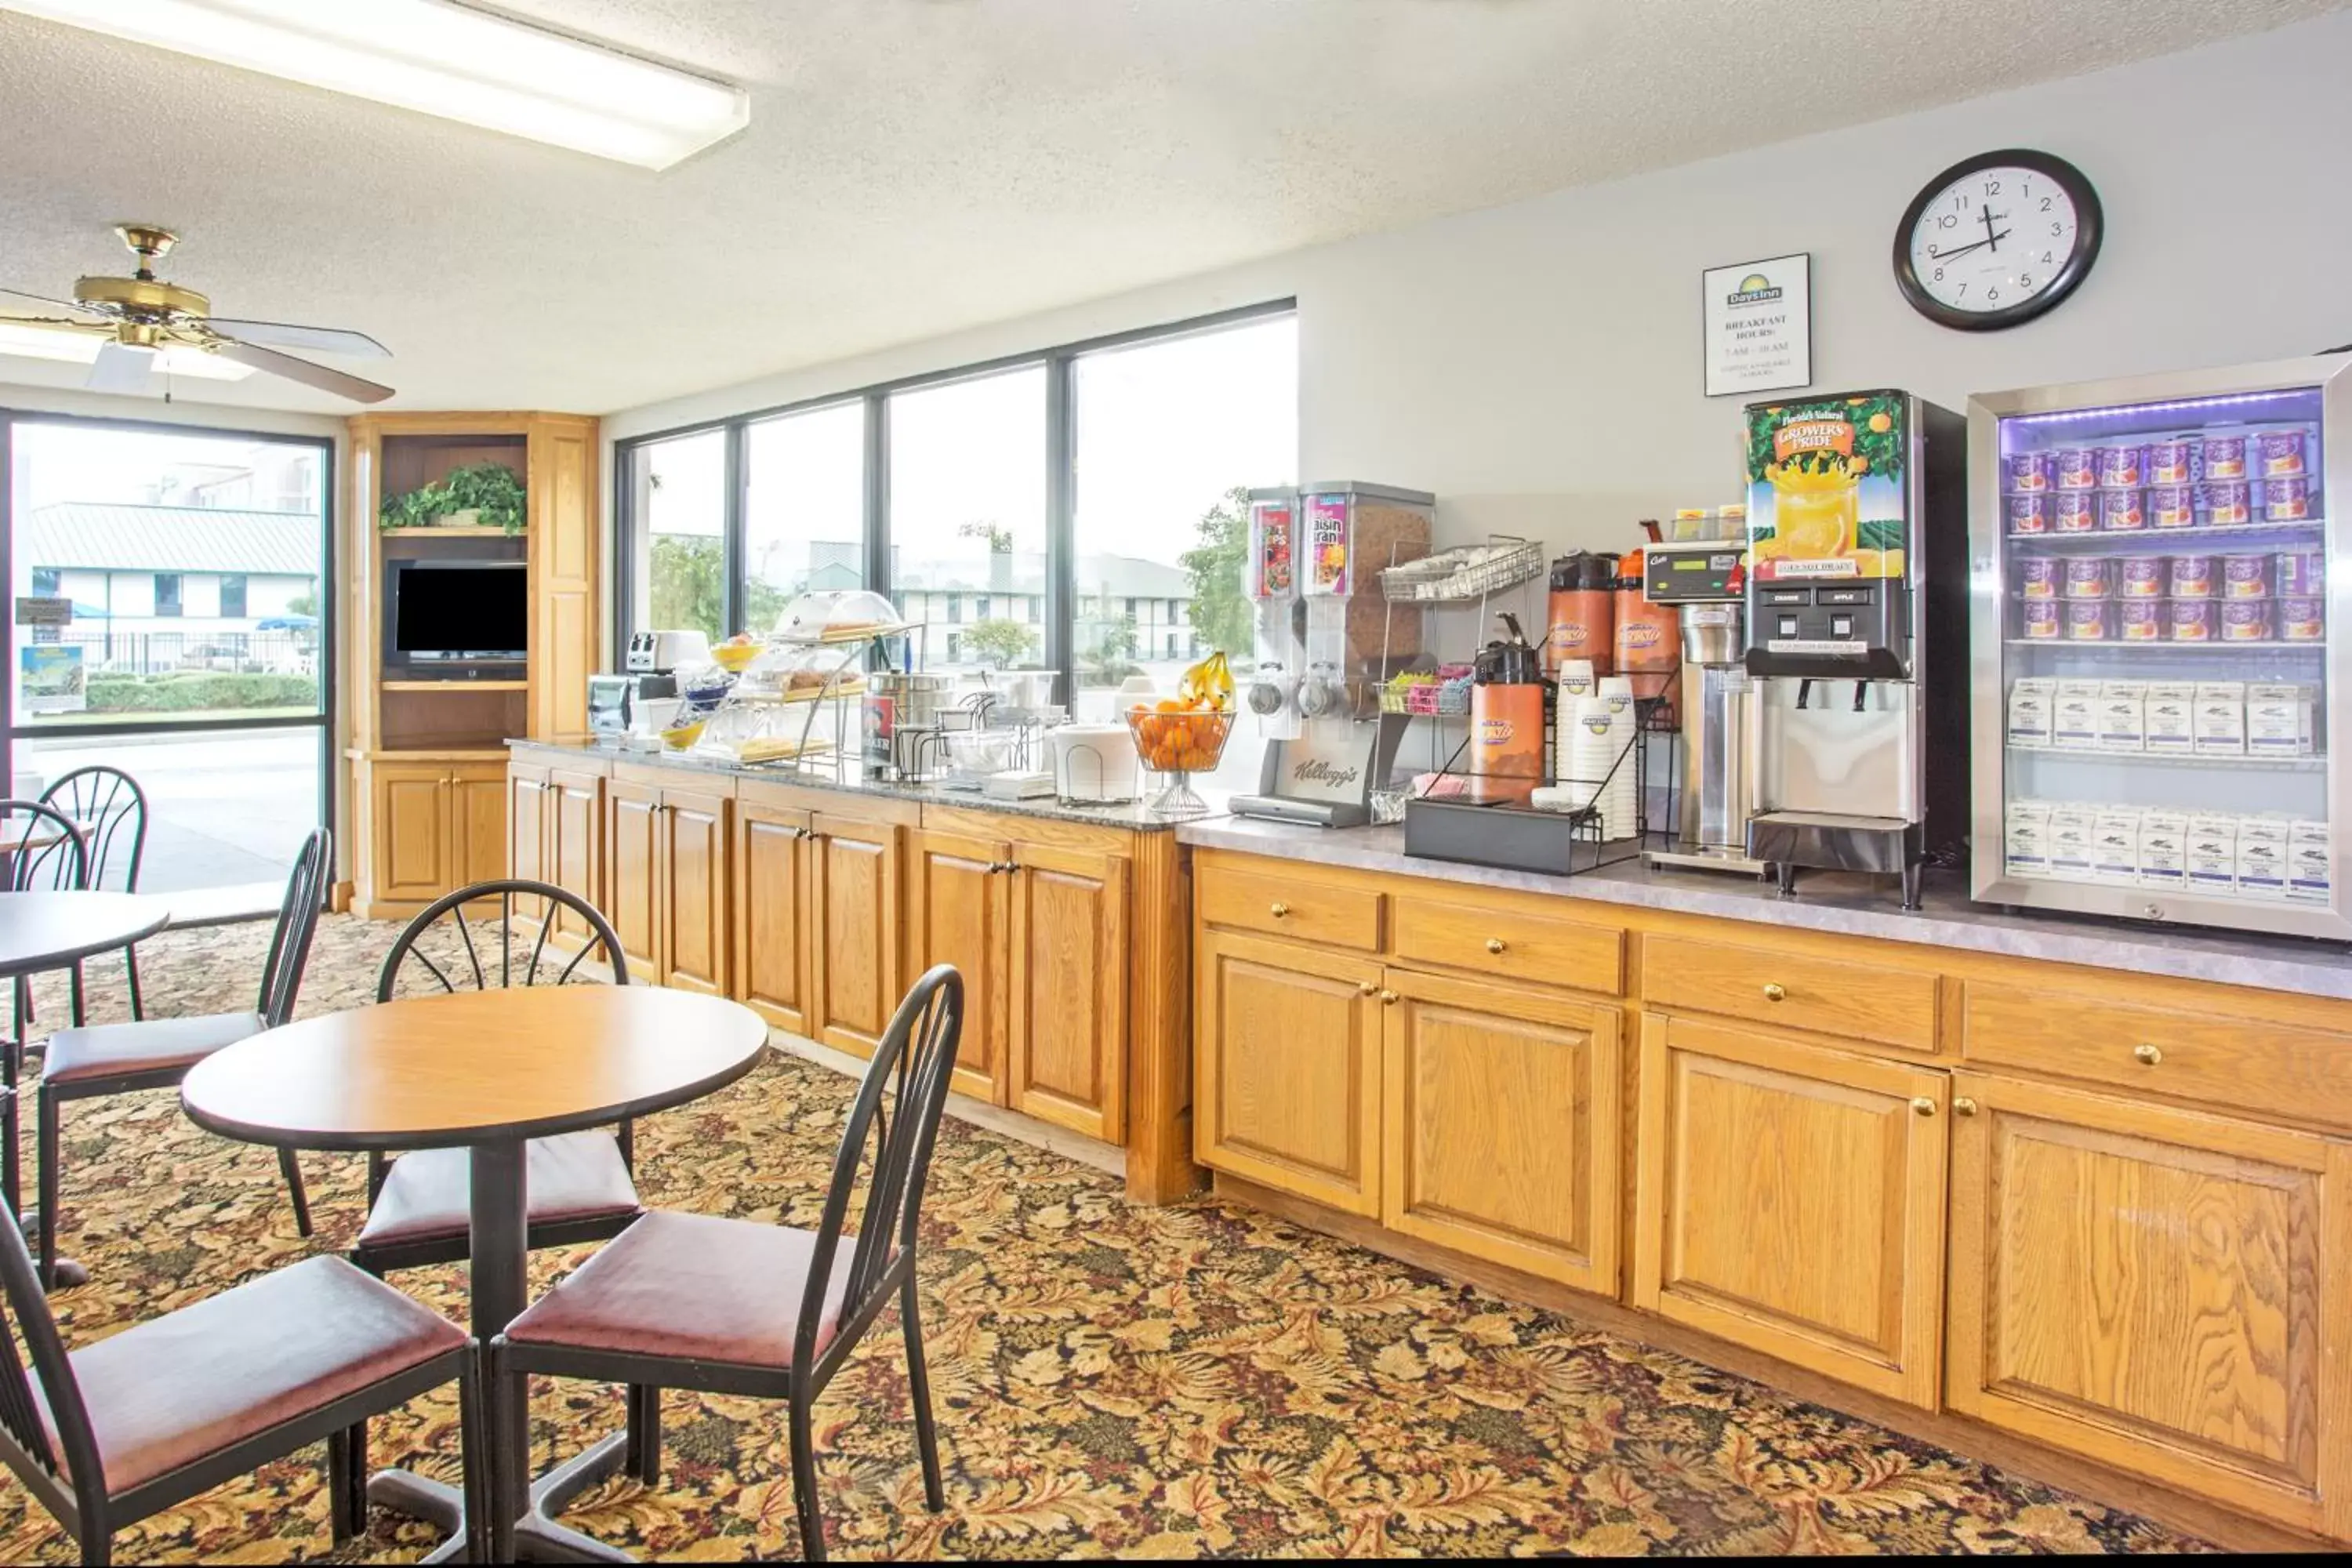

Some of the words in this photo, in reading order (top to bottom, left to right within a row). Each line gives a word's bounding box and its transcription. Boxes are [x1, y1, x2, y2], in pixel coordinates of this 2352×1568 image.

[1984, 182, 2000, 196] 12
[2023, 184, 2029, 198] 1
[1955, 196, 1968, 211] 11
[2040, 198, 2051, 212] 2
[1937, 214, 1958, 230] 10
[2051, 222, 2062, 237] 3
[1928, 244, 1938, 258] 9
[2042, 251, 2053, 264] 4
[1934, 267, 1944, 281] 8
[2020, 274, 2031, 288] 5
[1760, 288, 1780, 299] Inn
[1958, 283, 1967, 297] 7
[1987, 286, 1998, 300] 6
[1726, 314, 1786, 330] BREAKFAST
[1792, 435, 1832, 449] PRIDE
[1312, 518, 1341, 532] aisin
[1313, 532, 1337, 543] ran
[1294, 758, 1359, 788] Kellogg's
